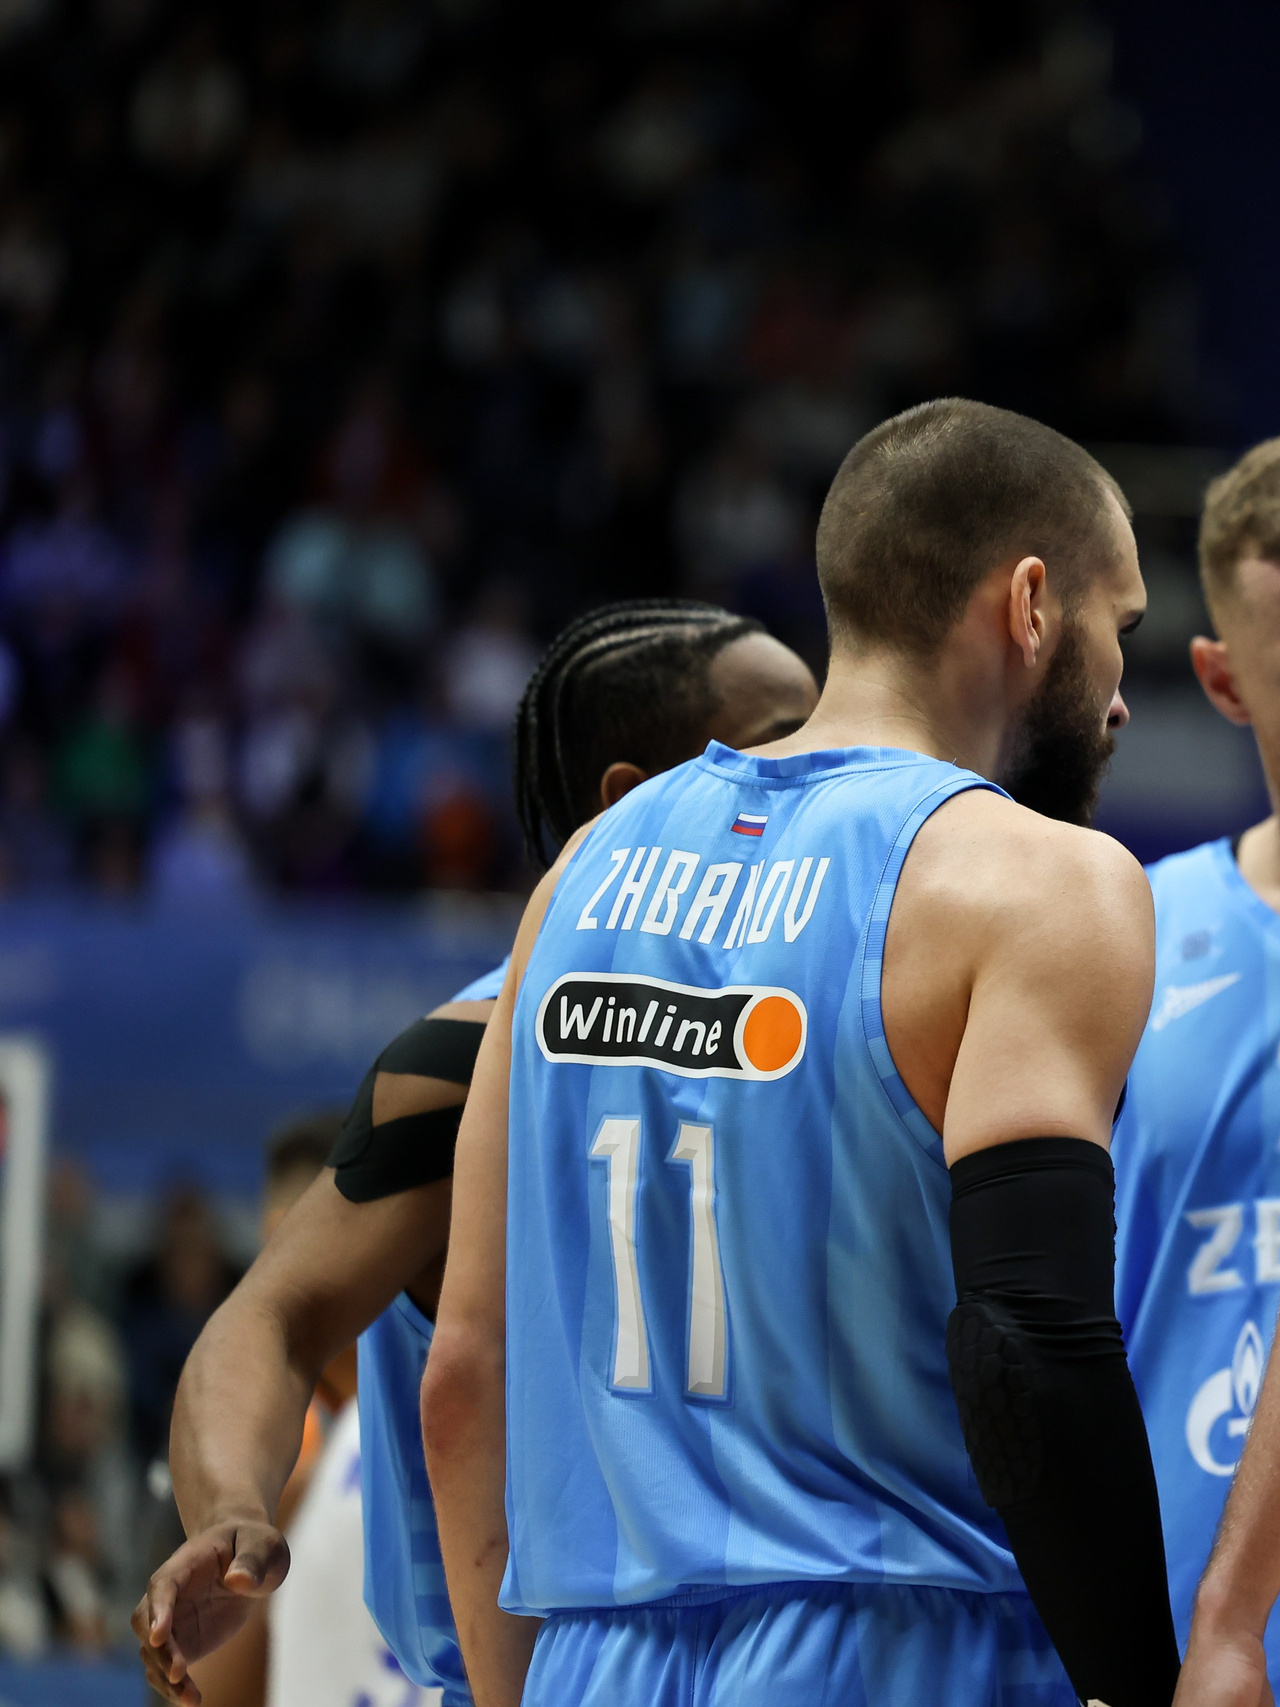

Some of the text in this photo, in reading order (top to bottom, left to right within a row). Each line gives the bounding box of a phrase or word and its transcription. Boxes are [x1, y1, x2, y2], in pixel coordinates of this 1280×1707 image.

[576, 846, 831, 949] ZHBANOV
[560, 995, 722, 1055] Winline
[590, 1119, 727, 1396] 11
